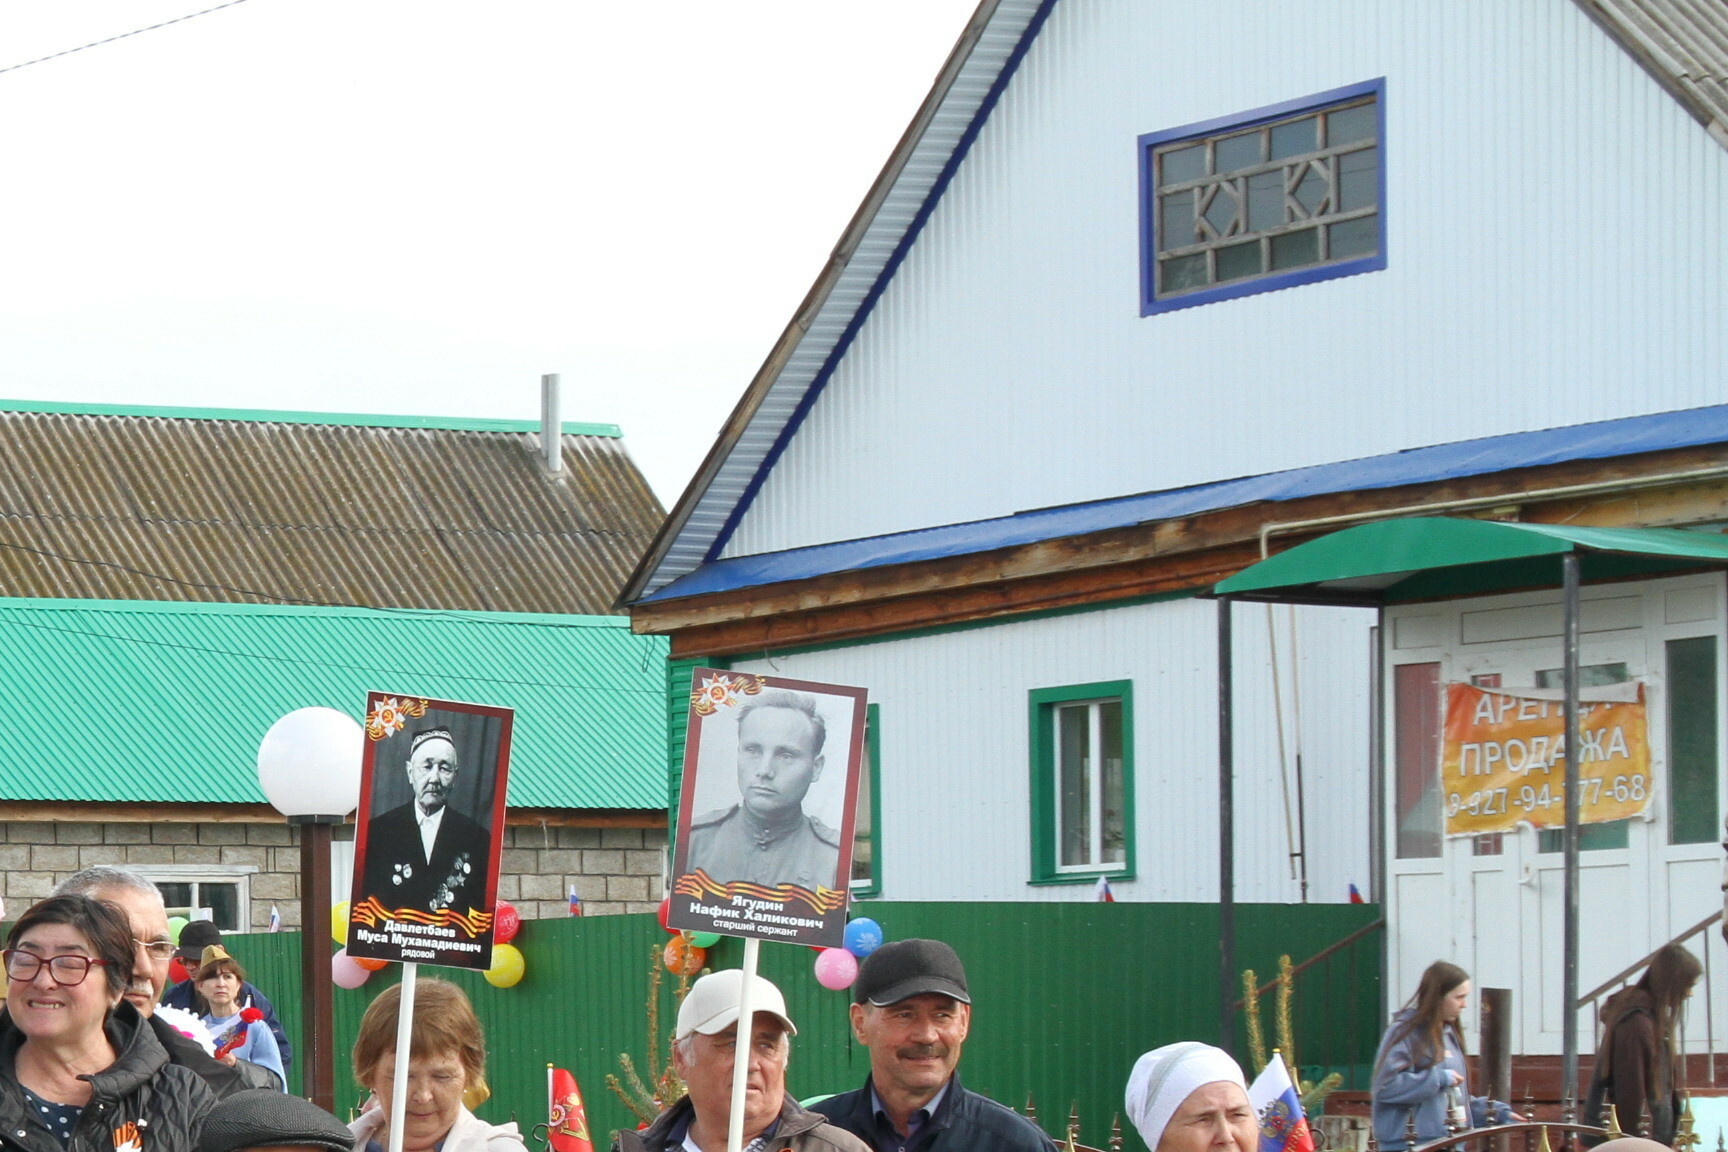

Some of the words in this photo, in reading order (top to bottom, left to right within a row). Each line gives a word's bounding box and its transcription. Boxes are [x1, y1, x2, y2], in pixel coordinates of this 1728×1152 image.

[1460, 726, 1629, 776] ПРОДАЖА
[732, 896, 784, 912] Ягудин
[690, 902, 740, 919] Нафик
[744, 908, 824, 929] Халикович
[384, 919, 456, 938] Давлетбаев
[713, 919, 756, 932] старший
[757, 924, 799, 937] сержант
[357, 929, 389, 944] Муса
[391, 933, 482, 953] Мухамадиевич
[401, 948, 435, 959] рядовой
